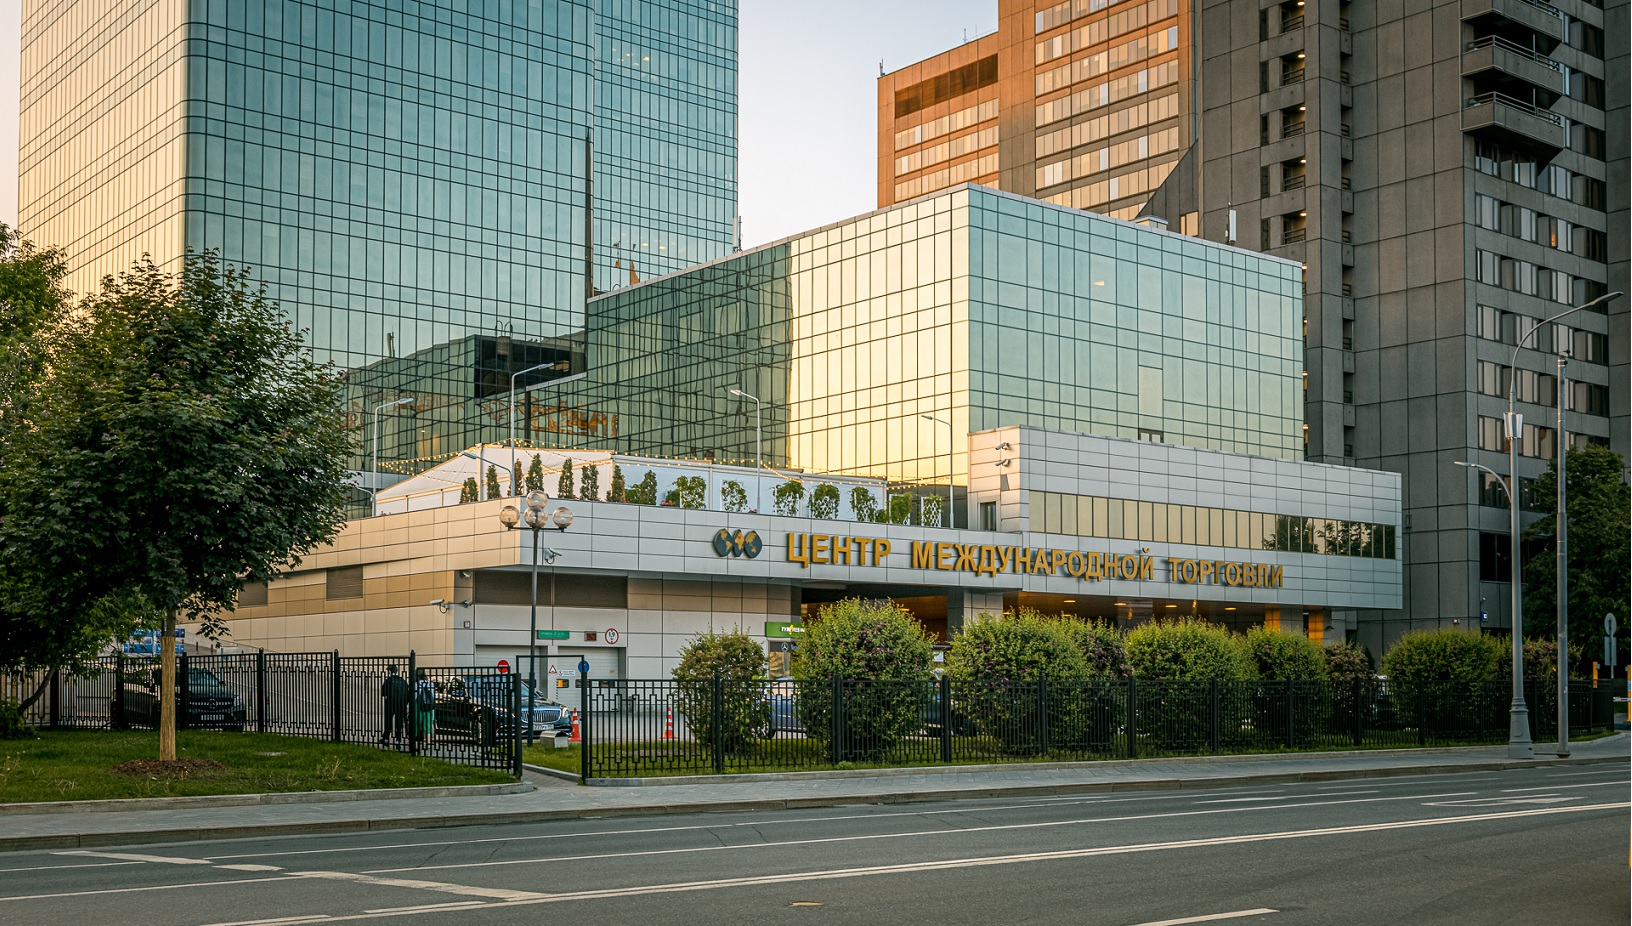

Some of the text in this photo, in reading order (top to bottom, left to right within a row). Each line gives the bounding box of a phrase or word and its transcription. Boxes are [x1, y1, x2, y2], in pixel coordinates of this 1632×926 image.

[787, 532, 1284, 588] ЦЕНТР МЕЖДУНАРОДНОЙ ТОРГОВЛИ
